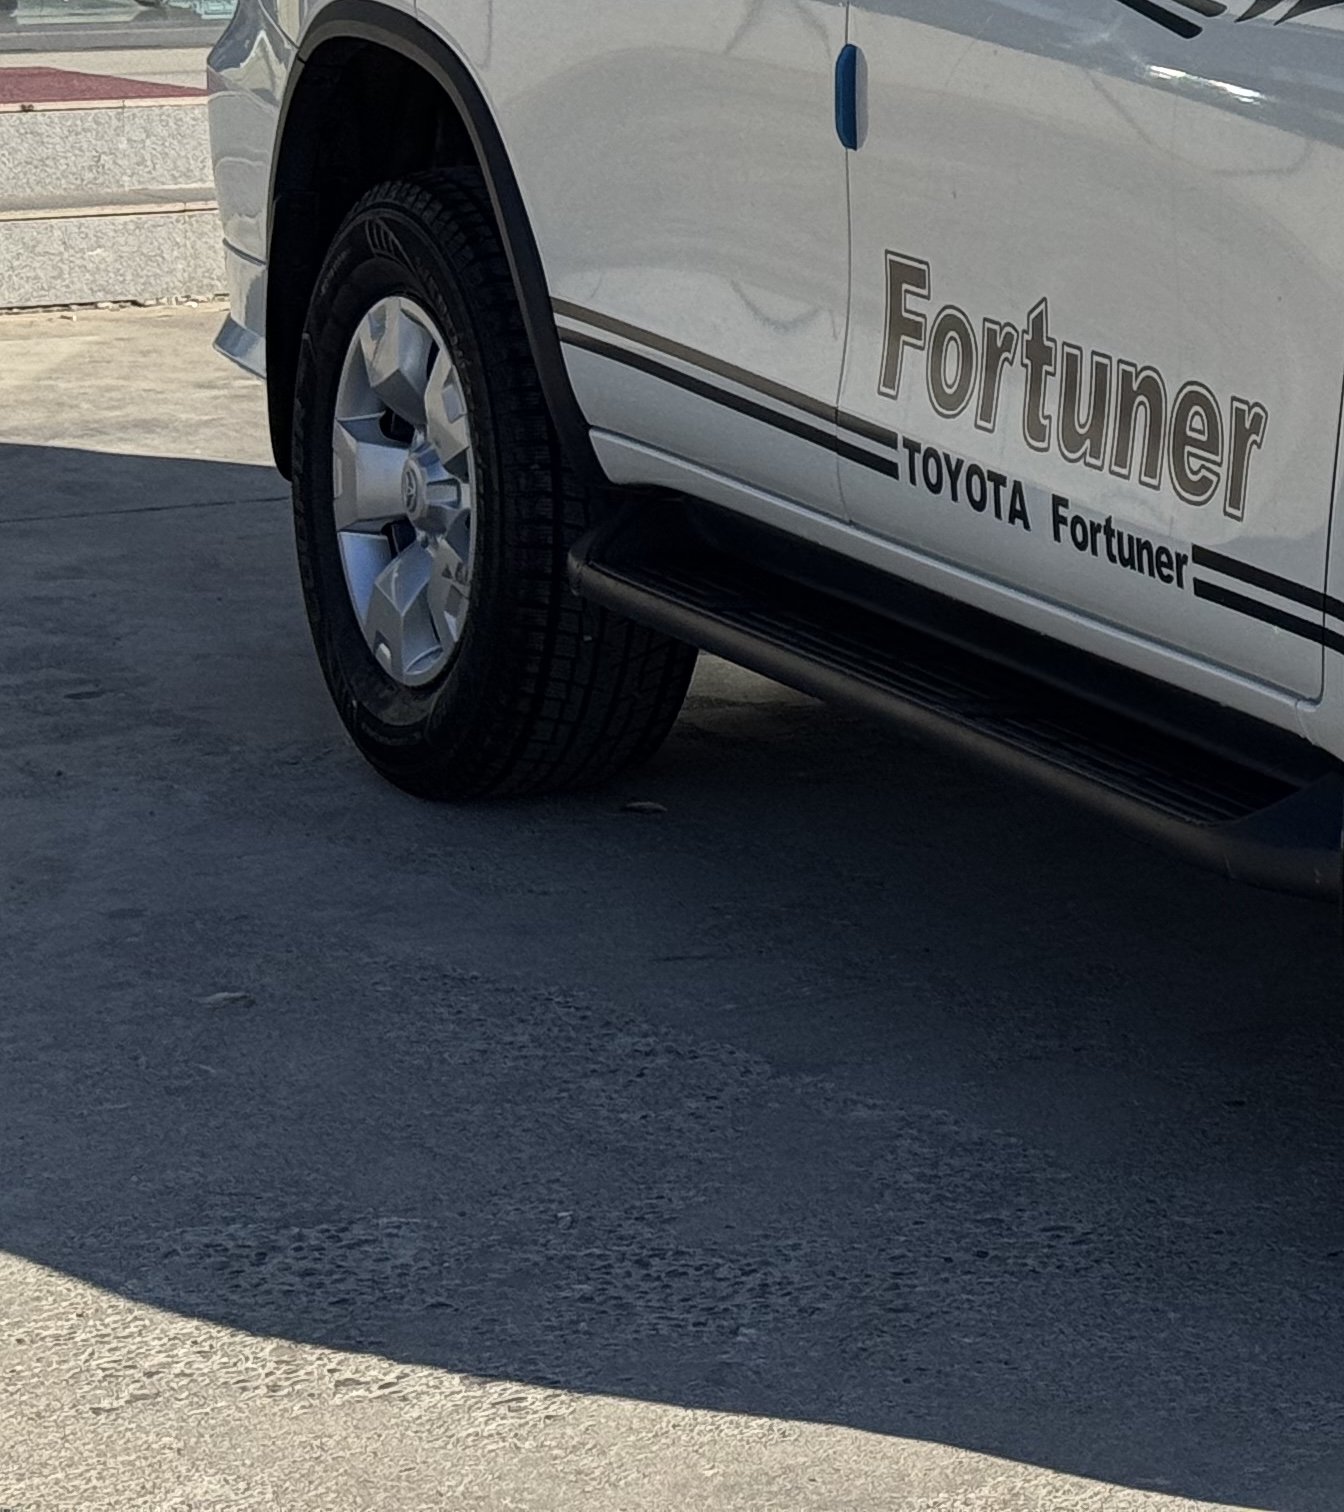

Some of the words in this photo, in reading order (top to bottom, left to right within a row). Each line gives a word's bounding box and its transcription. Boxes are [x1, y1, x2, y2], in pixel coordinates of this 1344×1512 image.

[878, 249, 1267, 521] Fortuner
[902, 437, 1031, 531] TOYOTA
[1051, 494, 1189, 589] Fortuner
